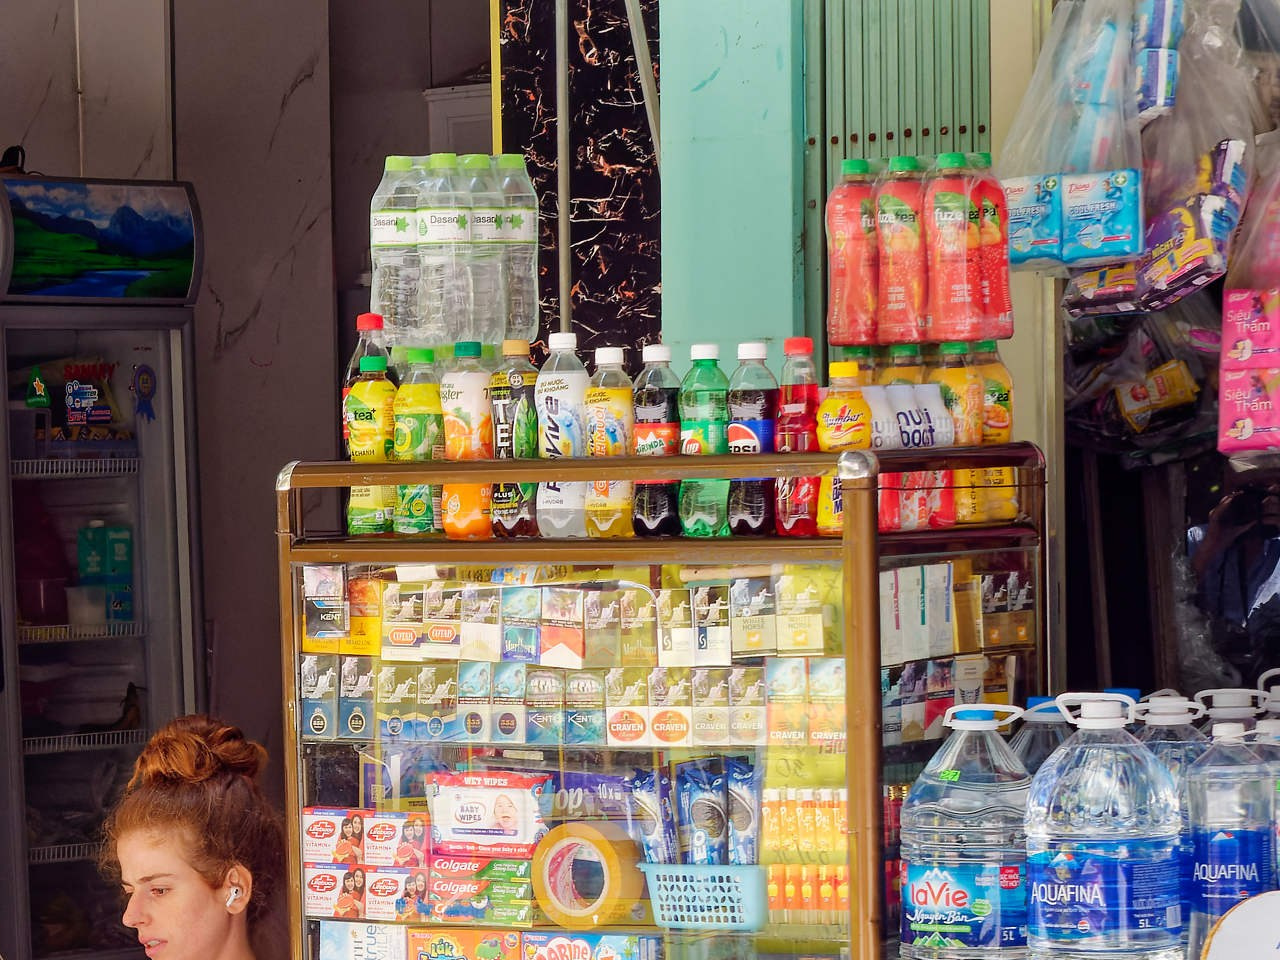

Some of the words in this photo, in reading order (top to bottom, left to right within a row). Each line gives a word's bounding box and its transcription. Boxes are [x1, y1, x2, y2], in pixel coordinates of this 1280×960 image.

[430, 215, 460, 225] Dasan
[320, 613, 342, 621] KENT
[309, 826, 334, 835] Lifebuoy
[370, 829, 395, 838] Lifebuoy
[434, 859, 479, 871] Colgate
[1193, 862, 1260, 882] AQUAFINA
[310, 880, 335, 888] Lifebuoy
[373, 884, 398, 892] Lifebuoy
[434, 880, 479, 893] Colgate
[911, 881, 969, 907] laVie
[1031, 882, 1106, 907] AQUAFINA
[1139, 919, 1150, 928] 5L
[1002, 930, 1015, 941] 5L
